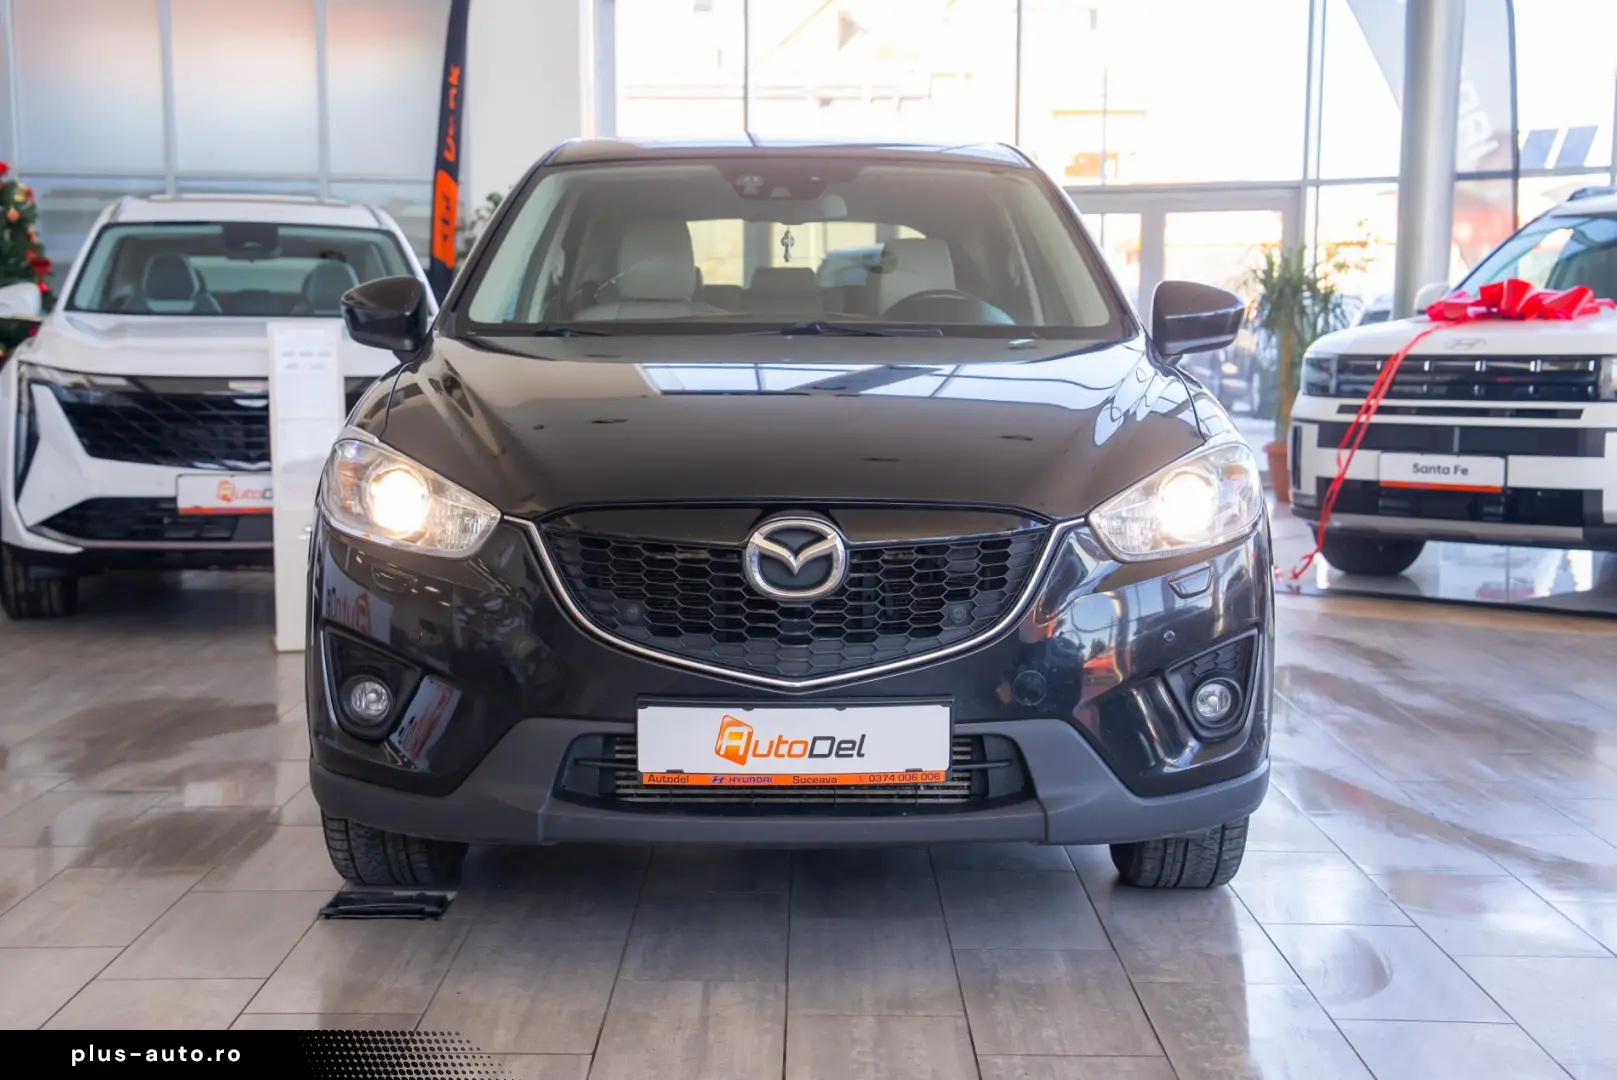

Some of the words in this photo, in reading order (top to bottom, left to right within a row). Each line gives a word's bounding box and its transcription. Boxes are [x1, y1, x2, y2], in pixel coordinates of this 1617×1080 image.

[1412, 462, 1450, 476] Santa
[1453, 464, 1469, 477] Fe
[715, 716, 866, 765] AutoDel
[647, 774, 689, 784] Autodel
[729, 776, 773, 784] HYUNDAI
[792, 775, 838, 784] Suceava
[868, 774, 895, 783] 0374
[898, 773, 918, 782] 006
[920, 772, 941, 781] 006
